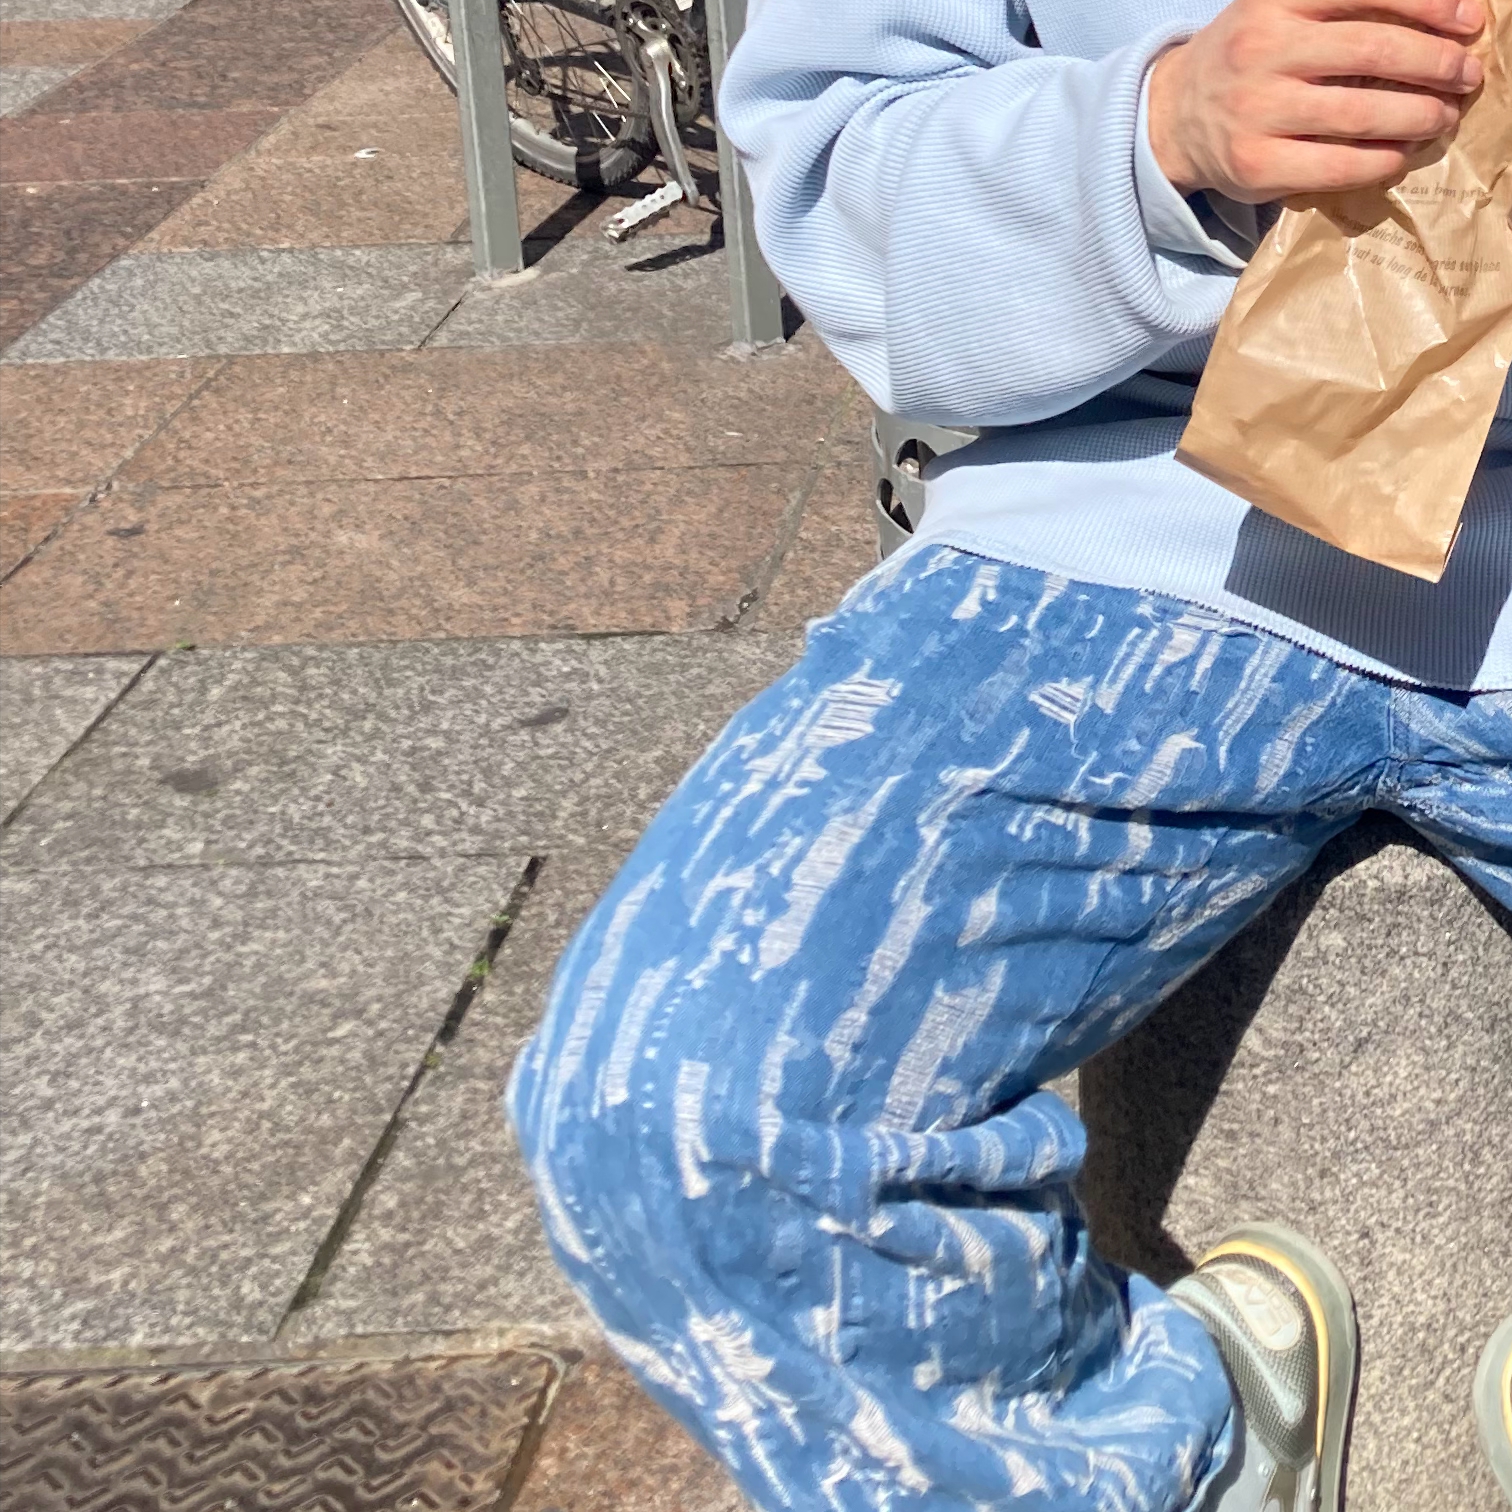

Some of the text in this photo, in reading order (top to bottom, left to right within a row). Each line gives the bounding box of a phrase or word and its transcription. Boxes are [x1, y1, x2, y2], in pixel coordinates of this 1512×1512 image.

[1370, 253, 1385, 266] au
[1387, 256, 1412, 279] long
[1413, 267, 1428, 282] de
